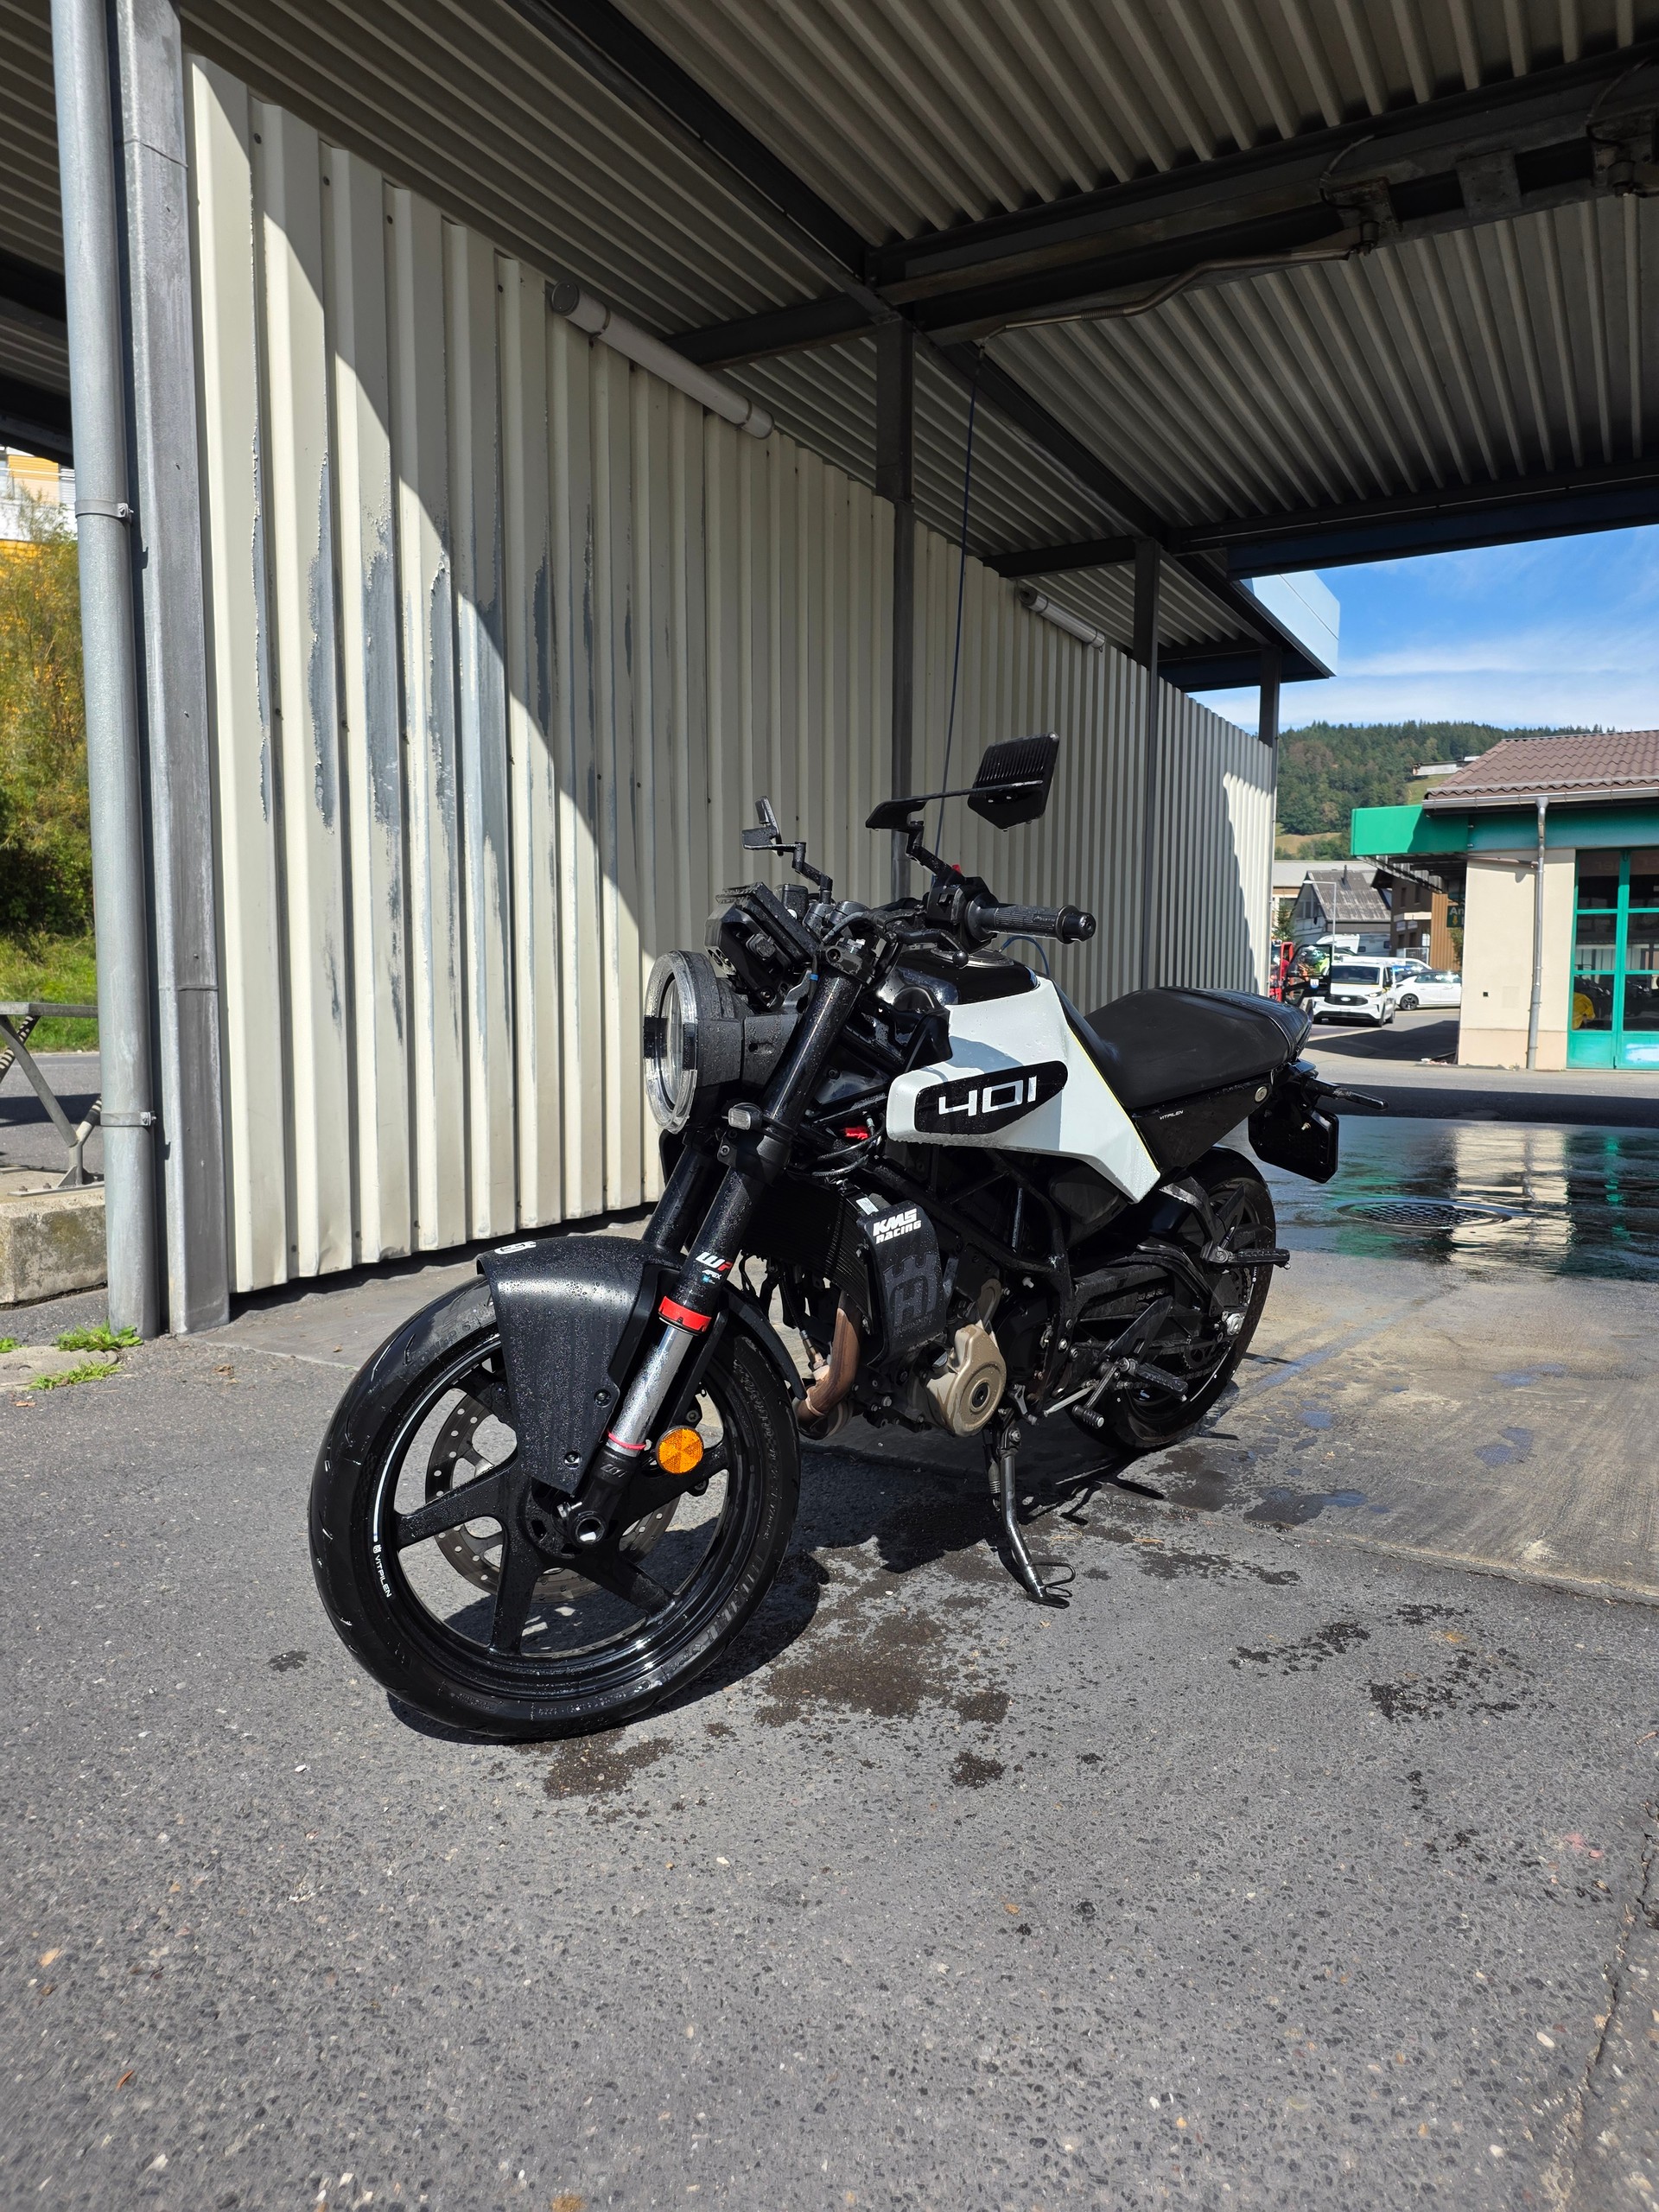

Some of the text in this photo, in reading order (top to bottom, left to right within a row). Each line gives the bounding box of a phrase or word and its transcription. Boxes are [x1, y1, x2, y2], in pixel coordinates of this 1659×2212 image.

[938, 1075, 1037, 1116] 401
[873, 1208, 917, 1236] KMS
[695, 1251, 733, 1271] WP
[375, 1554, 391, 1598] VITPILEN
